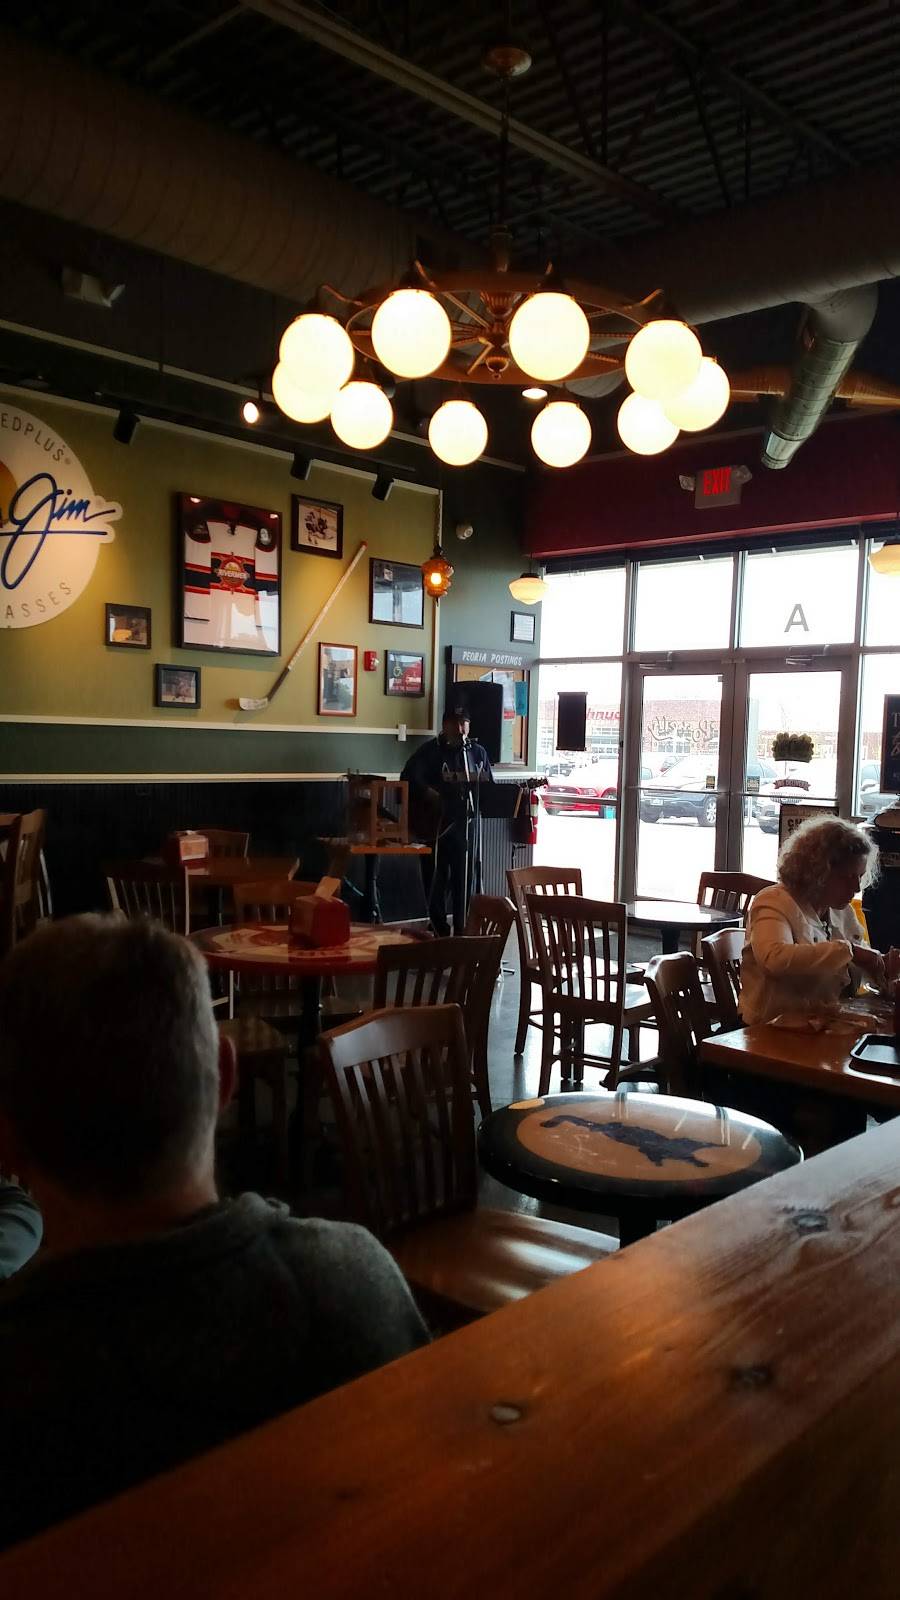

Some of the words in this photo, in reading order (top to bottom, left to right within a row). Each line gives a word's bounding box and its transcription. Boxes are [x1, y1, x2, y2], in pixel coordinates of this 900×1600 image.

[704, 467, 731, 496] EXIT
[784, 603, 809, 633] A
[462, 651, 487, 664] PEORIA
[491, 654, 523, 667] POSTINGS
